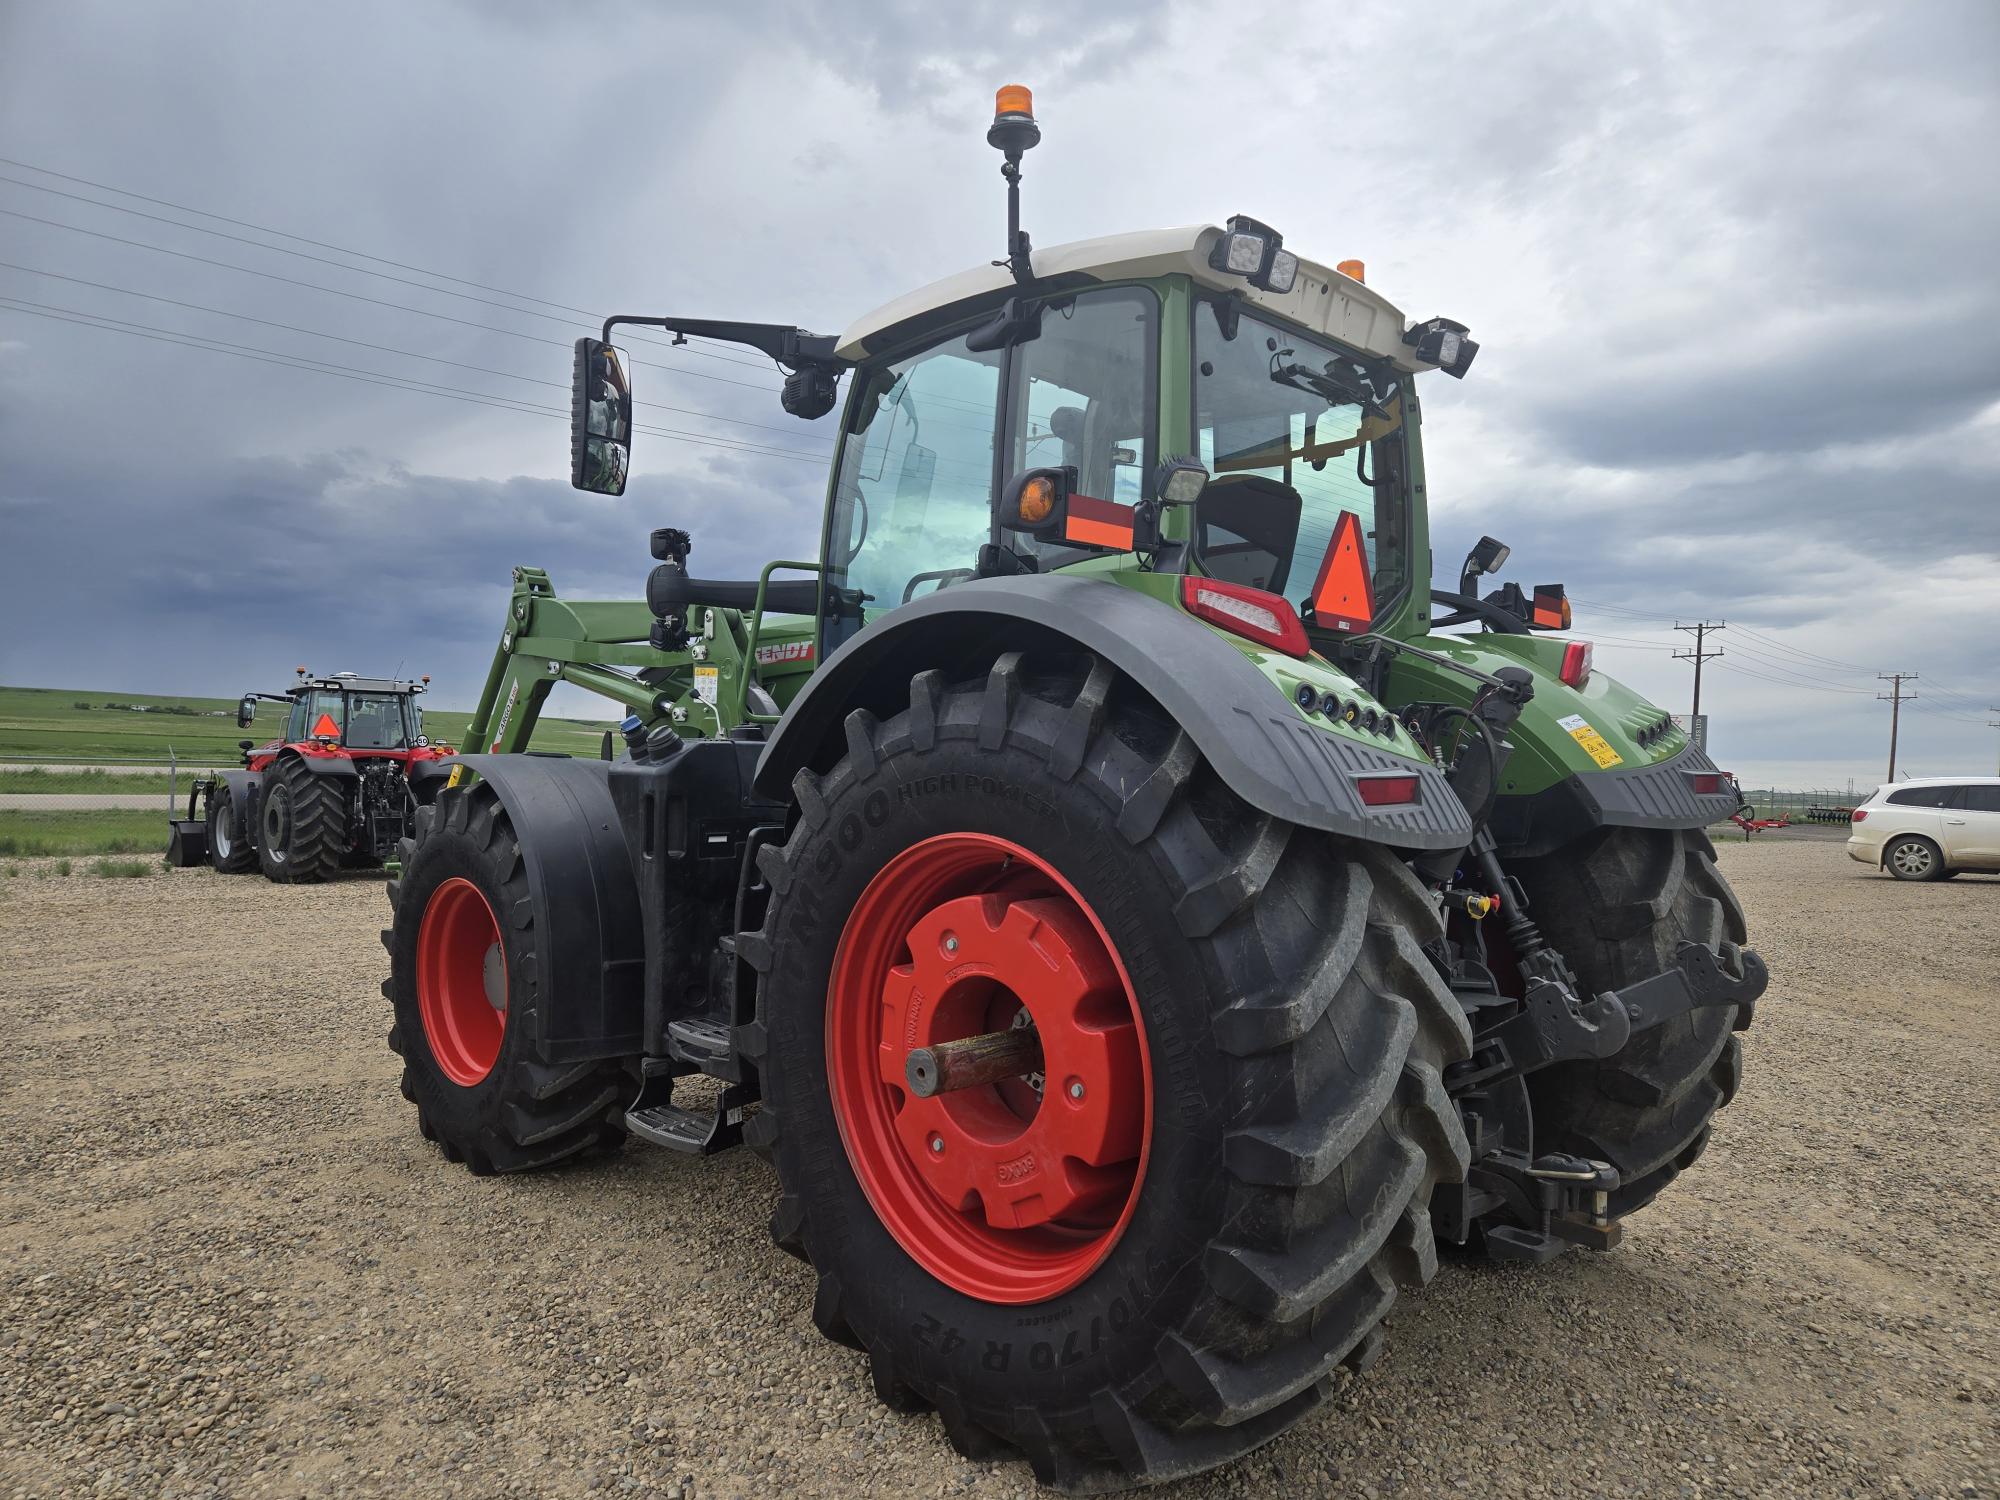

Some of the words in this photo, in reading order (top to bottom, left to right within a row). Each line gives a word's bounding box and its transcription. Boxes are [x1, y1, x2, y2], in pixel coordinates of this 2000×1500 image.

[498, 704, 511, 736] CARGO
[815, 788, 891, 886] 900
[897, 773, 958, 801] HIGH
[964, 773, 1058, 818] POWER
[911, 1311, 966, 1355] 42
[981, 1340, 1013, 1372] R
